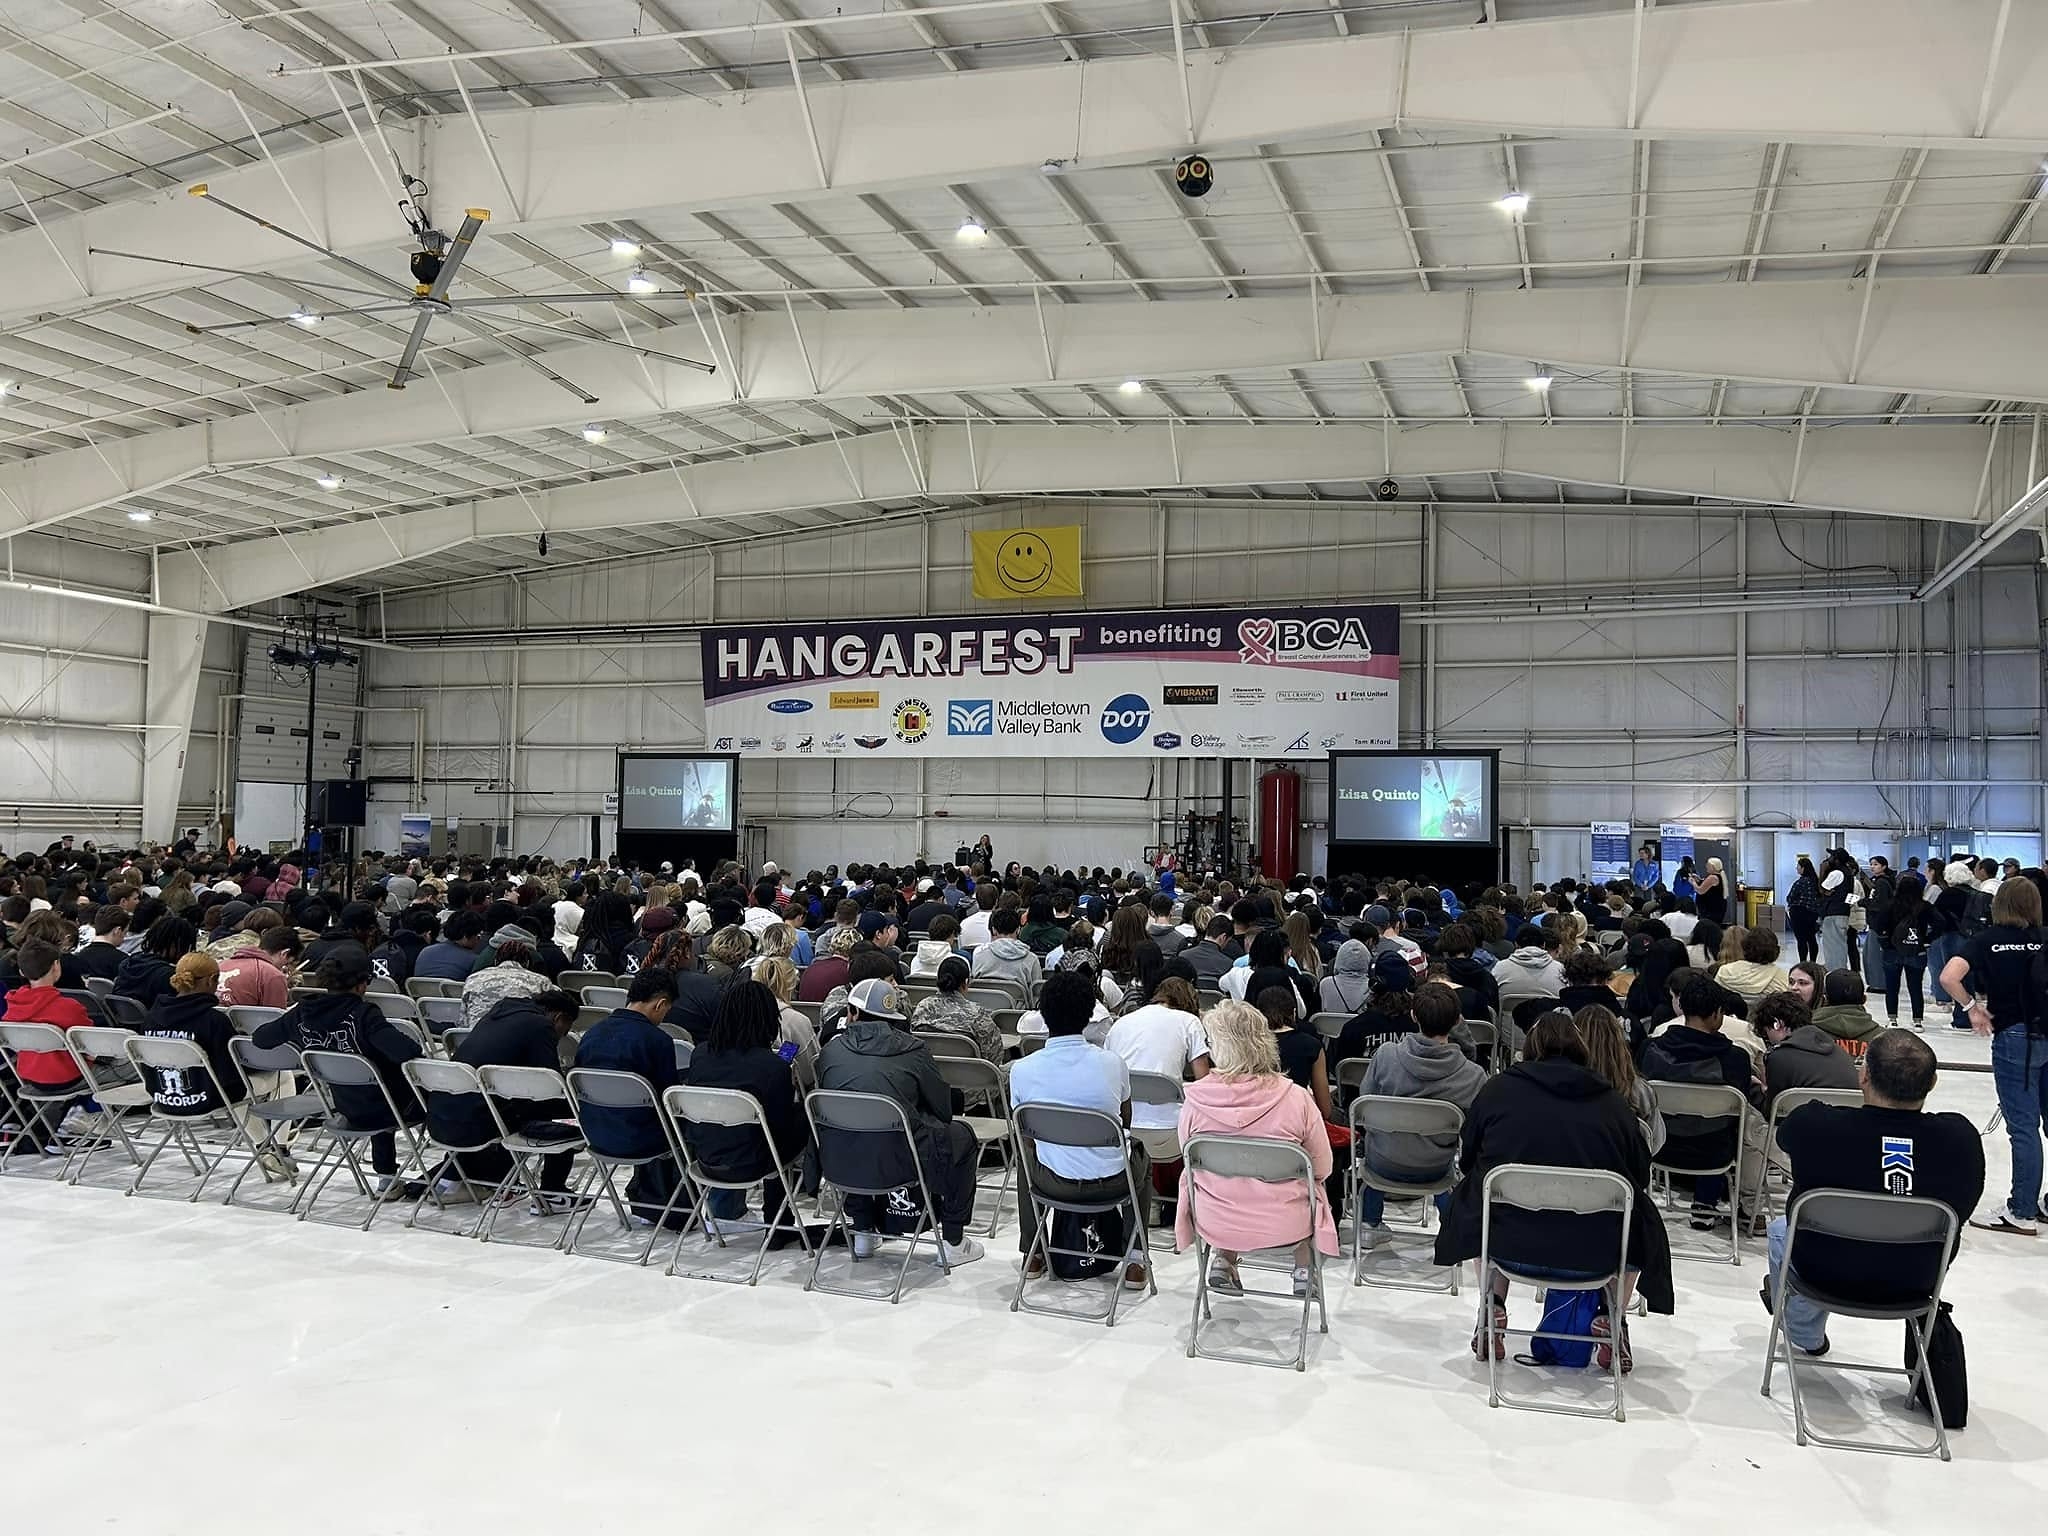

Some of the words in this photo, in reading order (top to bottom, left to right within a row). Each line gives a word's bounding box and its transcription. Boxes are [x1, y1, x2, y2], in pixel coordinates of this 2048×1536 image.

[1276, 618, 1371, 651] BCA
[717, 627, 1083, 681] HANGARFEST
[1100, 623, 1222, 648] benefiting
[1174, 688, 1215, 697] VIBRANT
[893, 699, 931, 717] HENSON
[998, 700, 1091, 716] Middletown
[997, 718, 1041, 737] Valley
[1043, 718, 1082, 734] Bank
[1103, 710, 1151, 729] DOT
[904, 731, 928, 744] SON
[625, 785, 646, 796] Lisa
[649, 785, 682, 797] Quinto
[1338, 788, 1368, 800] Lisa
[1372, 788, 1420, 802] Quinto
[1991, 943, 2025, 953] Career
[2027, 942, 2043, 951] Co
[153, 1091, 208, 1107] RECORDS
